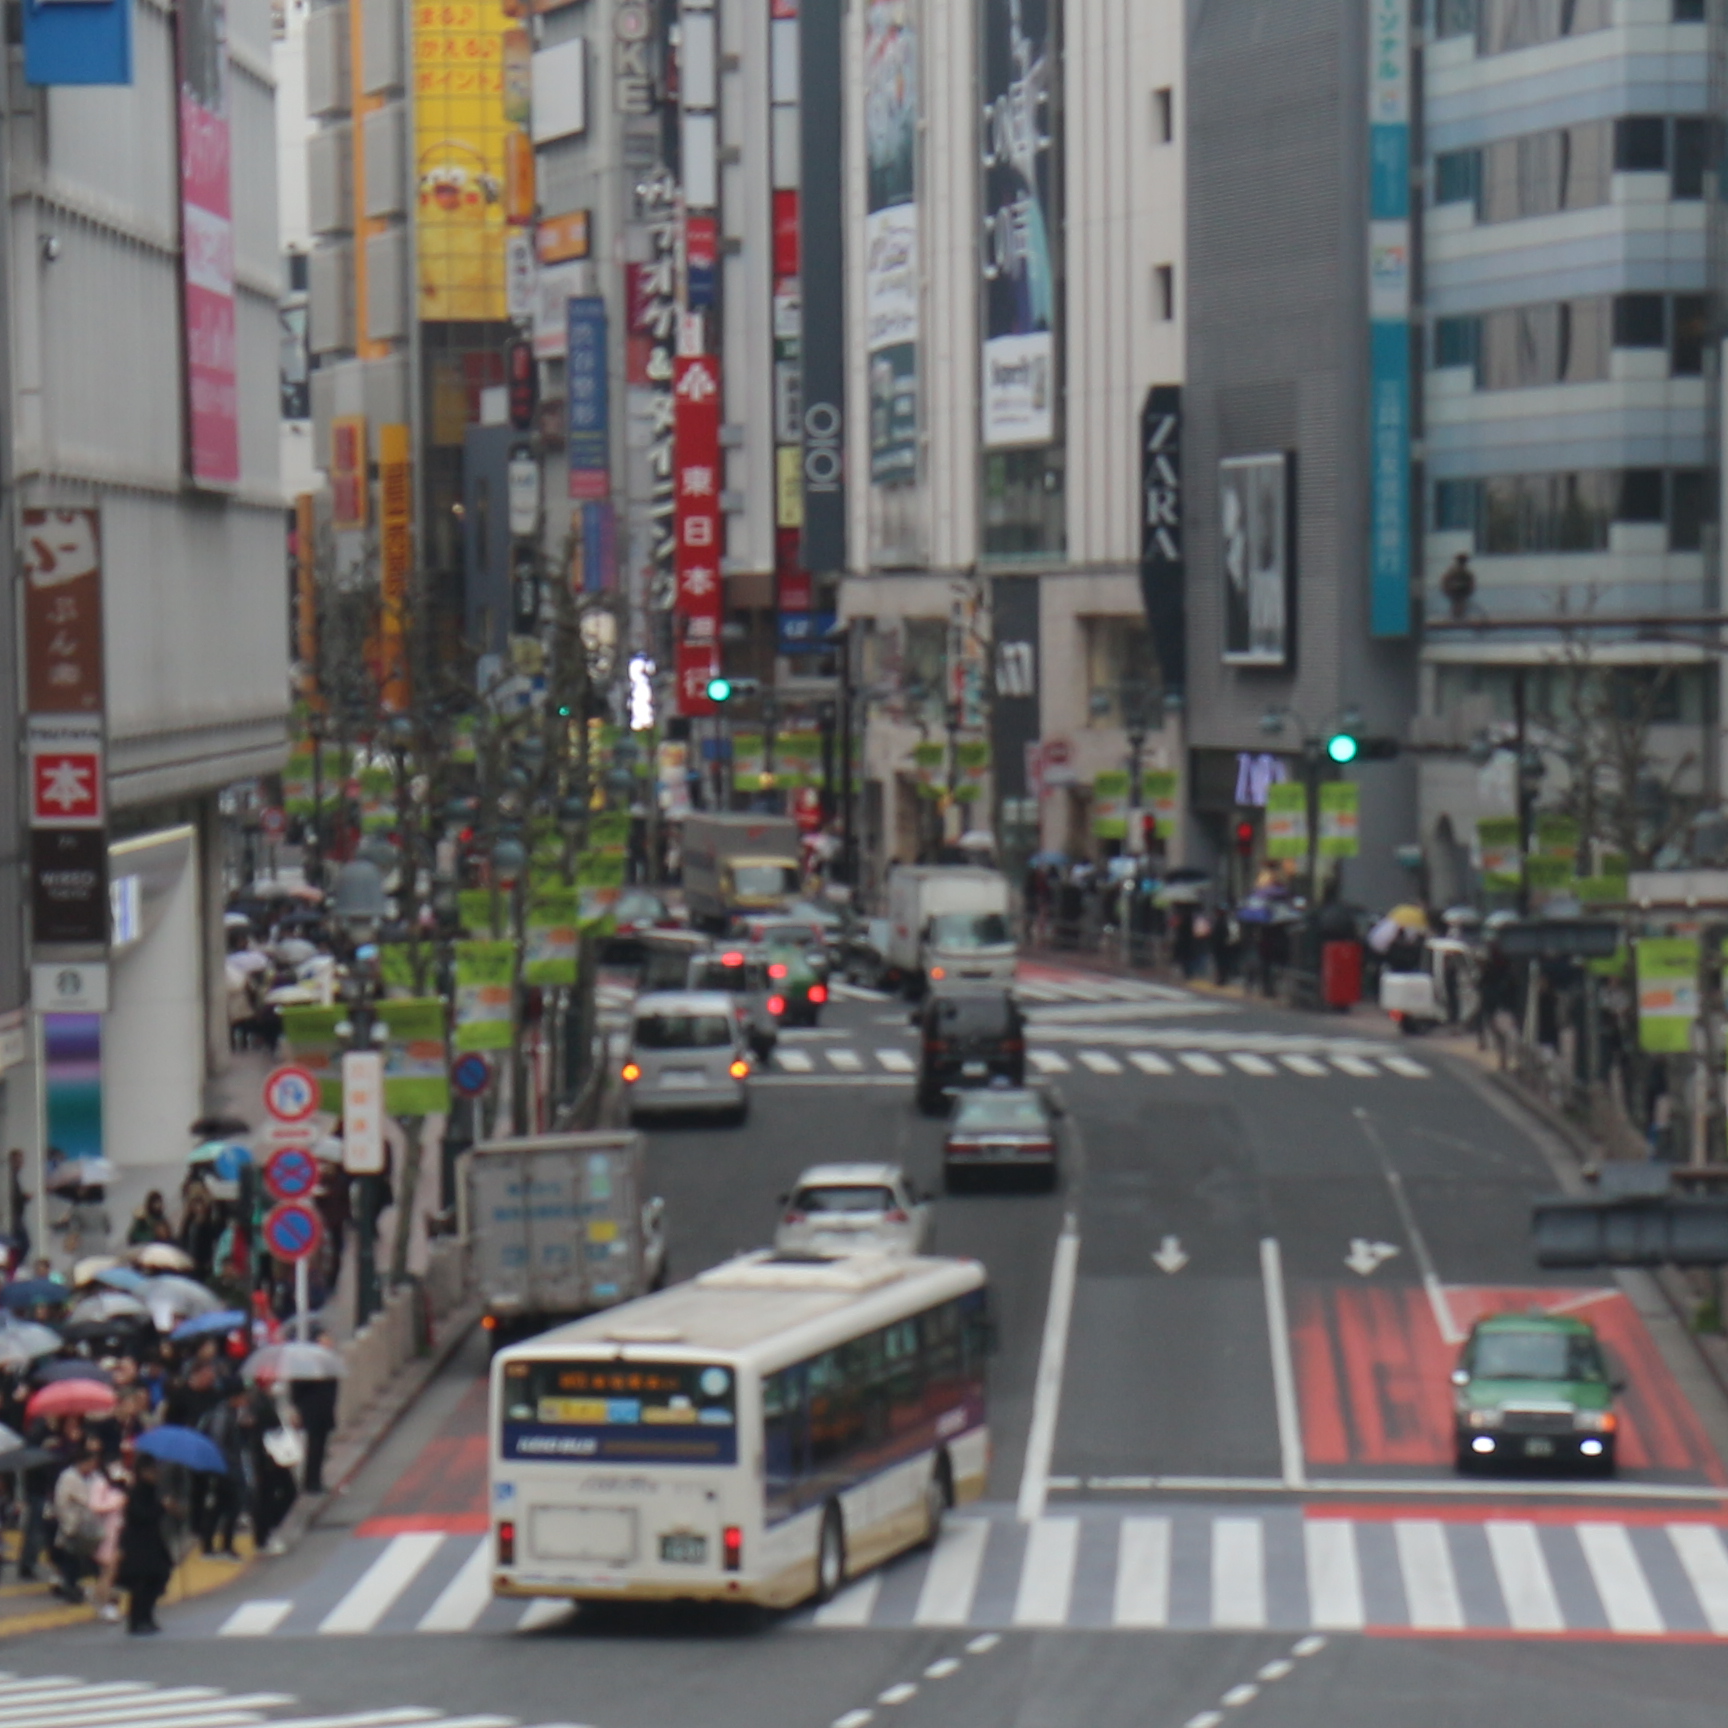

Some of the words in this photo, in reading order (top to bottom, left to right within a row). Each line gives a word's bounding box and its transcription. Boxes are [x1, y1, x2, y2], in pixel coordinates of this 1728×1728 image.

[614, 1, 653, 114] OKE
[1145, 411, 1180, 563] ZARA
[40, 760, 91, 812] 本
